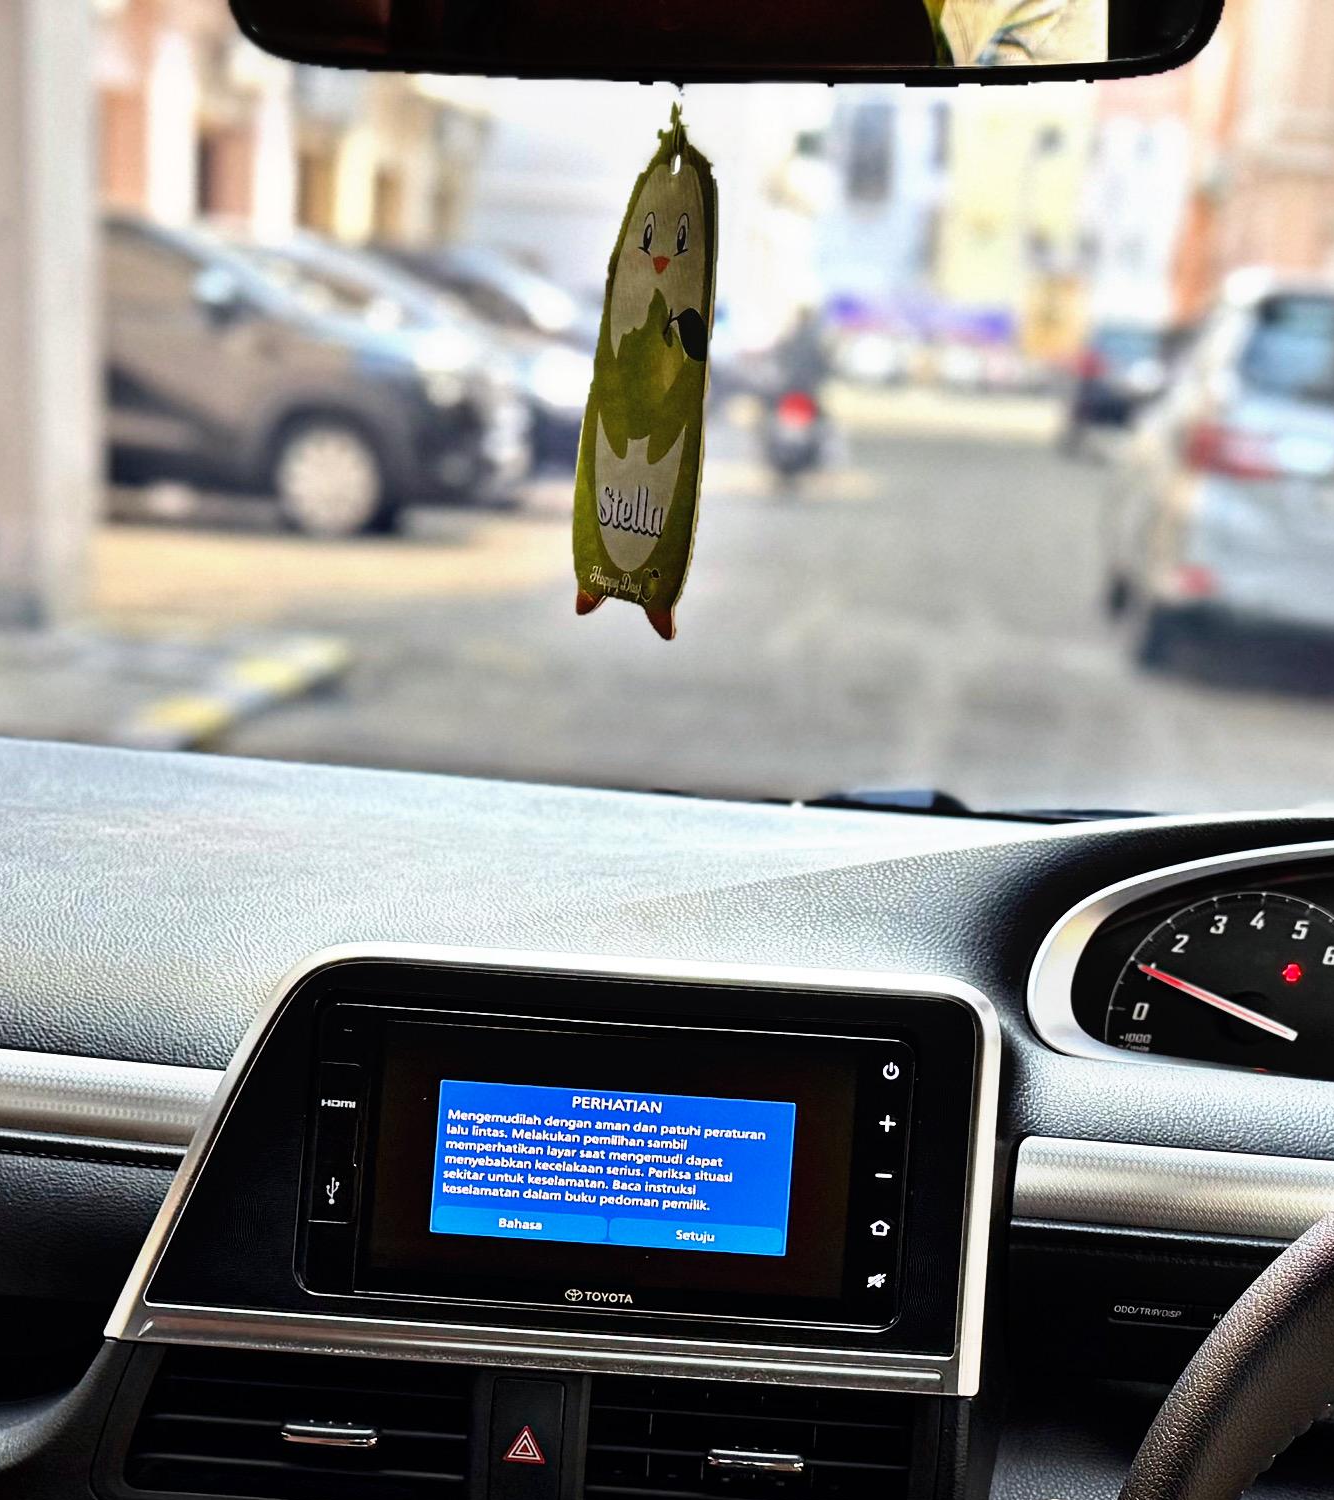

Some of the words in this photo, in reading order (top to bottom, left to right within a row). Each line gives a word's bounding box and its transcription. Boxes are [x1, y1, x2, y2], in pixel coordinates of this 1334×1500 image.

[598, 485, 663, 538] Stella
[590, 565, 620, 594] Happy
[1210, 915, 1228, 935] 3
[1250, 910, 1266, 930] 4
[1292, 920, 1309, 940] 5
[1171, 934, 1189, 953] 2
[1132, 1002, 1149, 1021] 0
[571, 1095, 663, 1114] PERHATIAN
[447, 1109, 542, 1127] Mengemudilah
[543, 1116, 592, 1131] dengan
[594, 1121, 631, 1132] aman
[633, 1122, 657, 1133] dan
[660, 1125, 701, 1137] patuhi
[703, 1127, 766, 1141] peraturan
[446, 1123, 468, 1136] lalu
[471, 1125, 508, 1139] lintas.
[511, 1128, 581, 1143] Melakukan
[583, 1133, 645, 1148] pemilihan
[647, 1138, 688, 1151] sambil
[445, 1140, 544, 1156] memperhatikan
[546, 1145, 576, 1159] layar
[579, 1149, 606, 1160] saat
[608, 1151, 683, 1165] mengemudi
[685, 1154, 723, 1168] dapat
[444, 1154, 532, 1170] menyebabkan
[534, 1159, 604, 1175] kecelakaan
[606, 1165, 645, 1177] serius.
[647, 1166, 692, 1181] Periksa
[694, 1171, 733, 1183] situasi
[442, 1169, 485, 1181] sekitar
[487, 1172, 524, 1185] untuk
[527, 1173, 609, 1190] keselamatan.
[612, 1180, 642, 1192] Baca
[644, 1181, 697, 1196] instruksi
[442, 1182, 520, 1199] keselamatan
[522, 1187, 562, 1202] dalam
[564, 1190, 596, 1204] buku
[599, 1194, 659, 1209] pedoman
[662, 1199, 711, 1211] pemilik.
[497, 1217, 543, 1231] Bahasa
[675, 1229, 716, 1244] Setuju
[584, 1291, 634, 1304] TOYOTA
